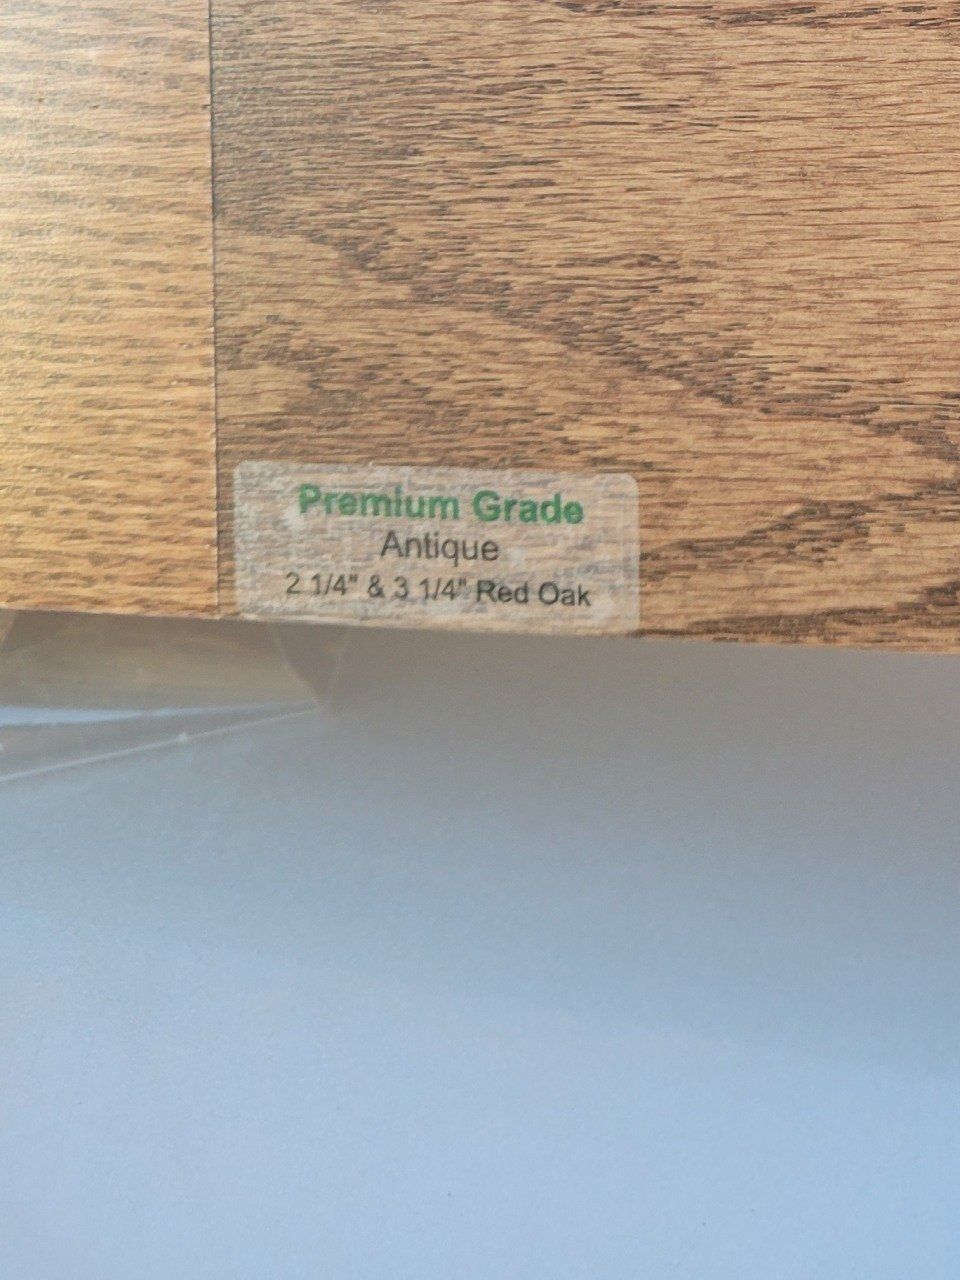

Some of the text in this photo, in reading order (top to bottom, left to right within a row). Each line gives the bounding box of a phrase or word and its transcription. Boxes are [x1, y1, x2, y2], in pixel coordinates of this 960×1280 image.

[299, 483, 584, 524] Premium Grade
[380, 530, 499, 567] Antique
[285, 572, 591, 607] 2 1/4" & 3 1/4" Red Oak
